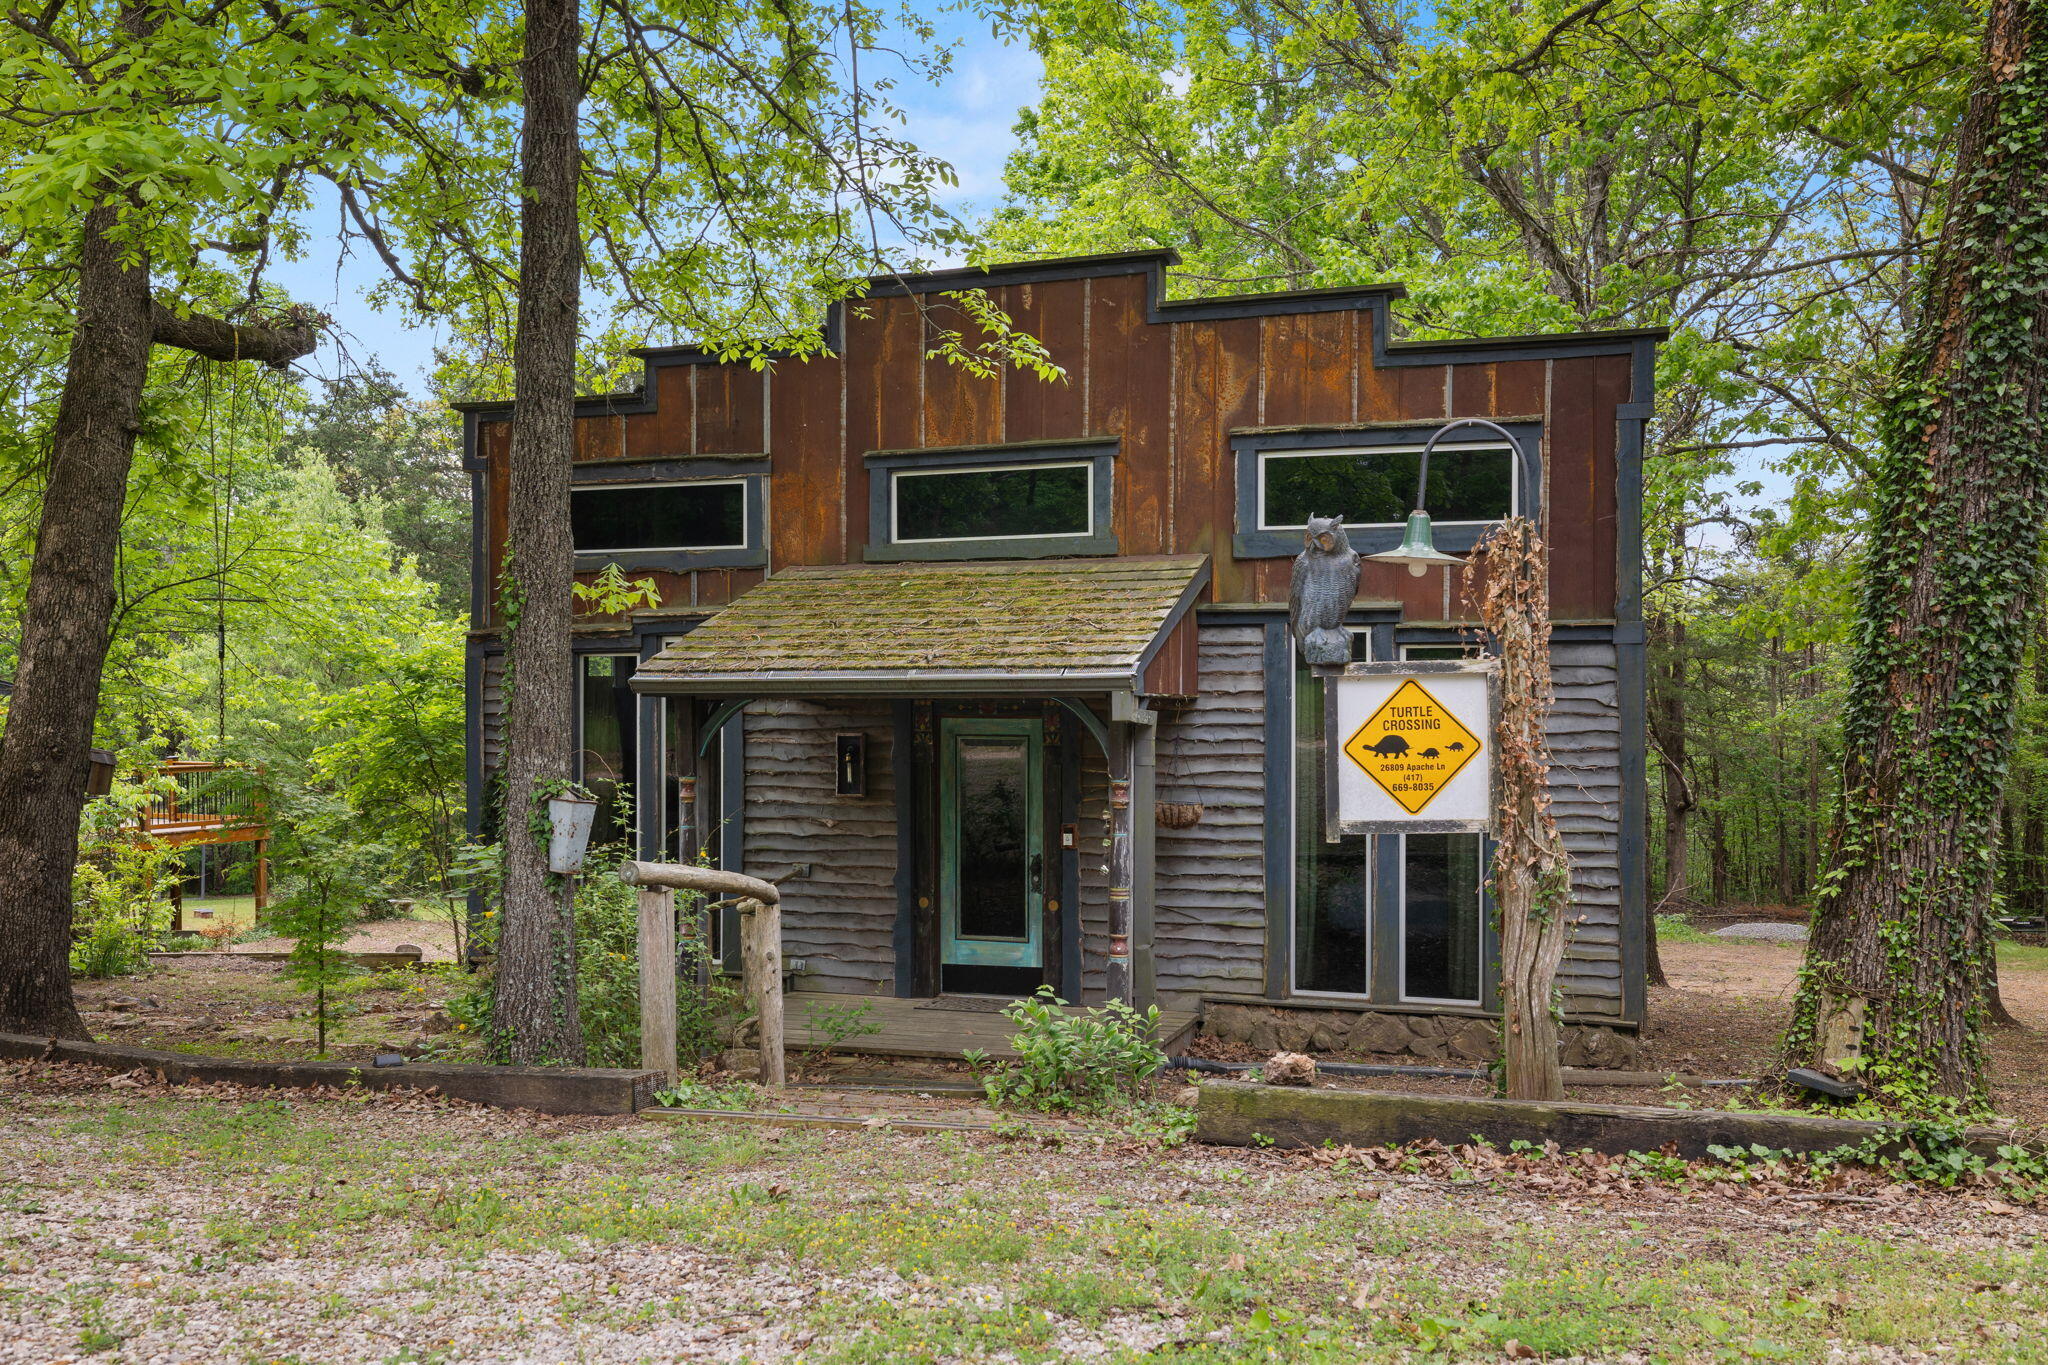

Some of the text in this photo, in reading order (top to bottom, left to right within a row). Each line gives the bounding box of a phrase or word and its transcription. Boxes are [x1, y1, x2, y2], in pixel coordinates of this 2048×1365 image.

[1390, 706, 1432, 717] TURTLE
[1383, 719, 1441, 731] CROSSING
[1380, 764, 1404, 772] 26809
[1407, 763, 1434, 772] Apache
[1403, 774, 1423, 782] (417)
[1392, 783, 1434, 792] 669-8035
